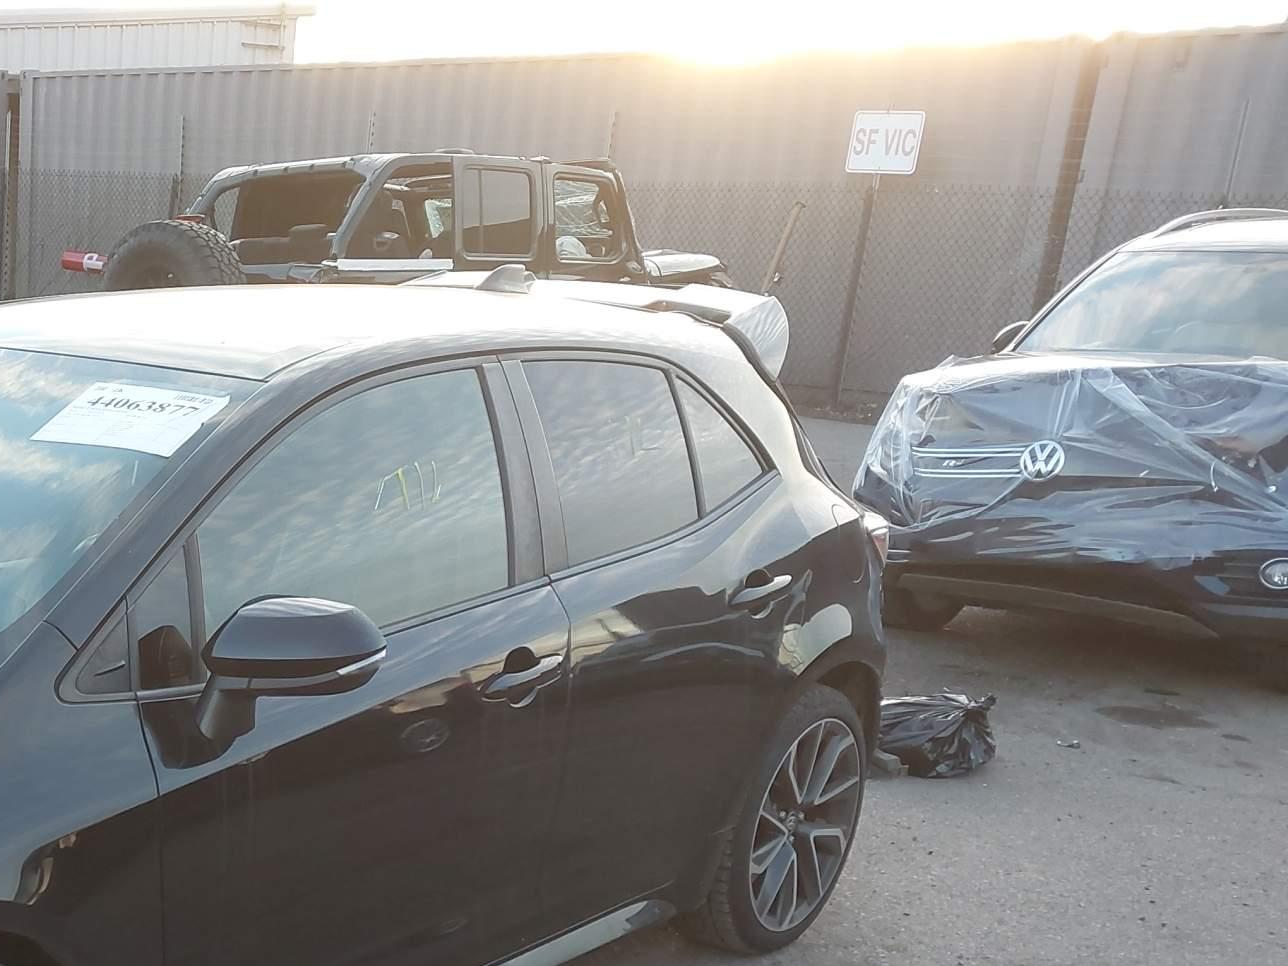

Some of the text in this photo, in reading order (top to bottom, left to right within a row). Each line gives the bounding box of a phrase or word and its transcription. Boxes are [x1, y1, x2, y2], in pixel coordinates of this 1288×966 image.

[853, 127, 917, 157] SF VIC
[87, 395, 201, 417] 44063877
